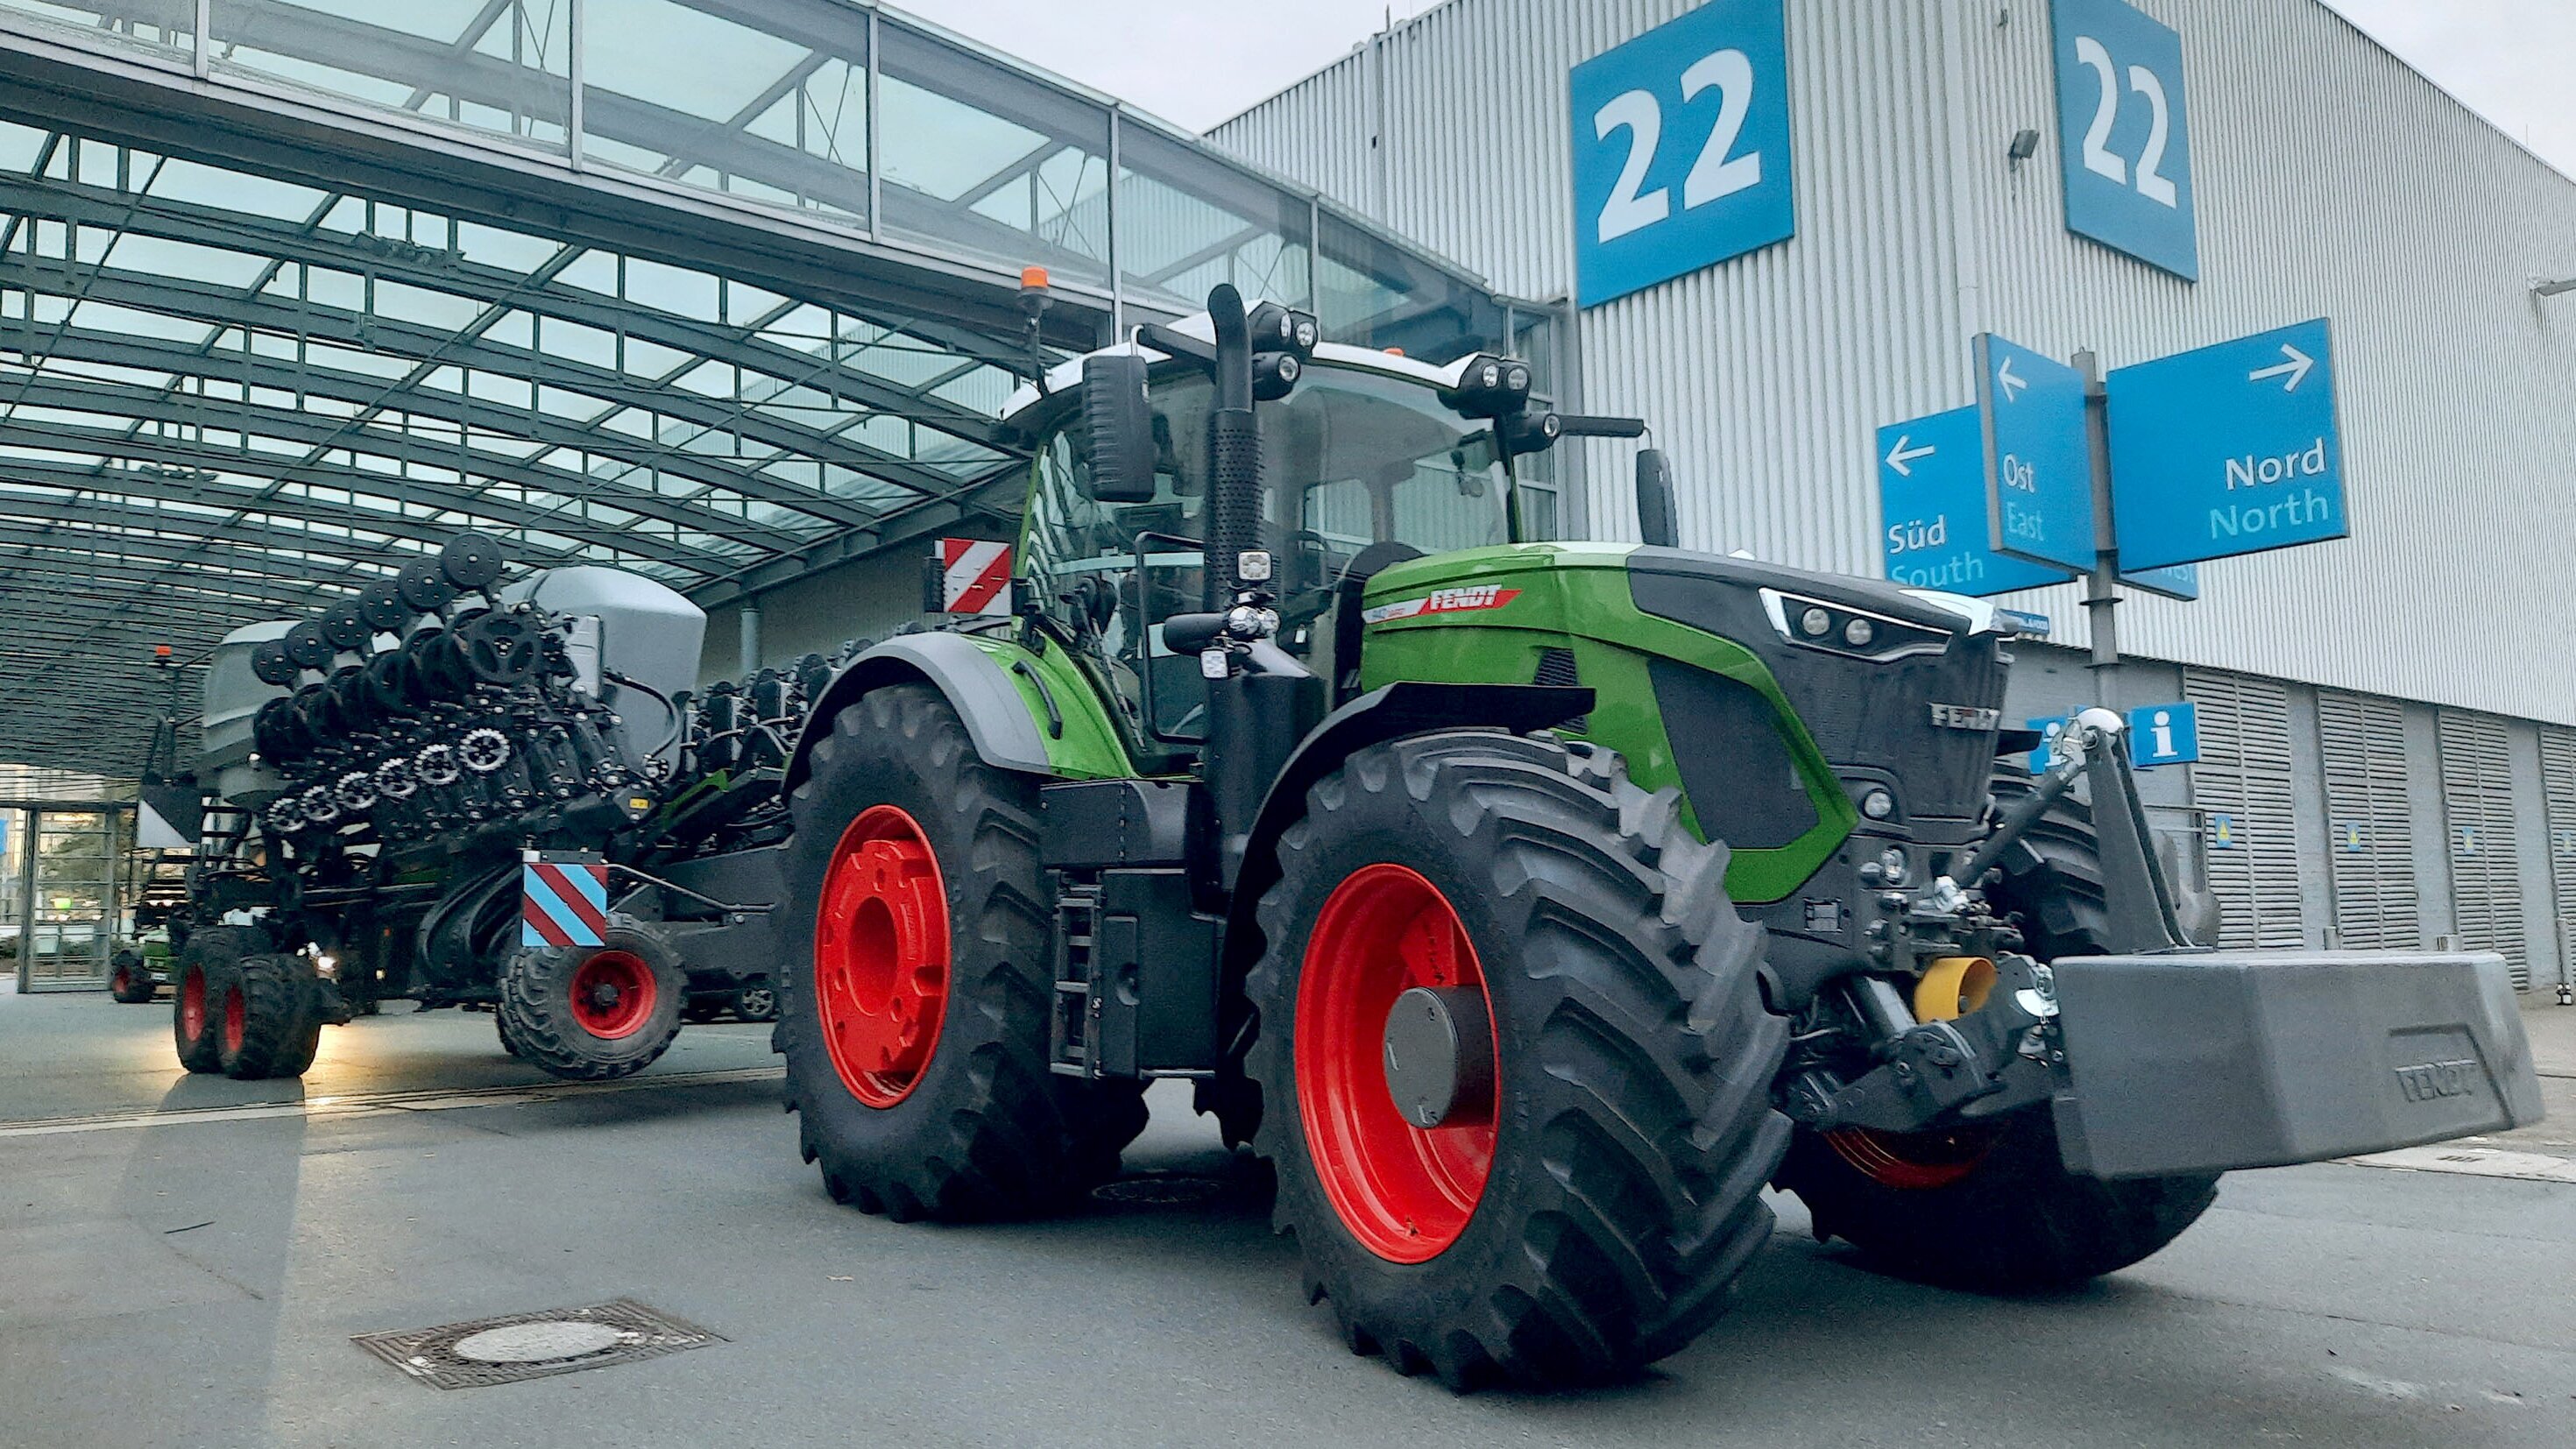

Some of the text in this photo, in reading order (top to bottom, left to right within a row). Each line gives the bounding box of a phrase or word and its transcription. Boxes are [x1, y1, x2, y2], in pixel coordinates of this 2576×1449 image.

[2075, 36, 2177, 209] 22
[1593, 48, 1761, 244] 22
[2003, 453, 2035, 493] Ost
[2226, 437, 2326, 491] Nord
[1888, 514, 1946, 554] Süd
[2006, 501, 2044, 541] East
[2210, 487, 2329, 541] North
[1891, 551, 1984, 588] South
[1430, 583, 1503, 611] FENDT
